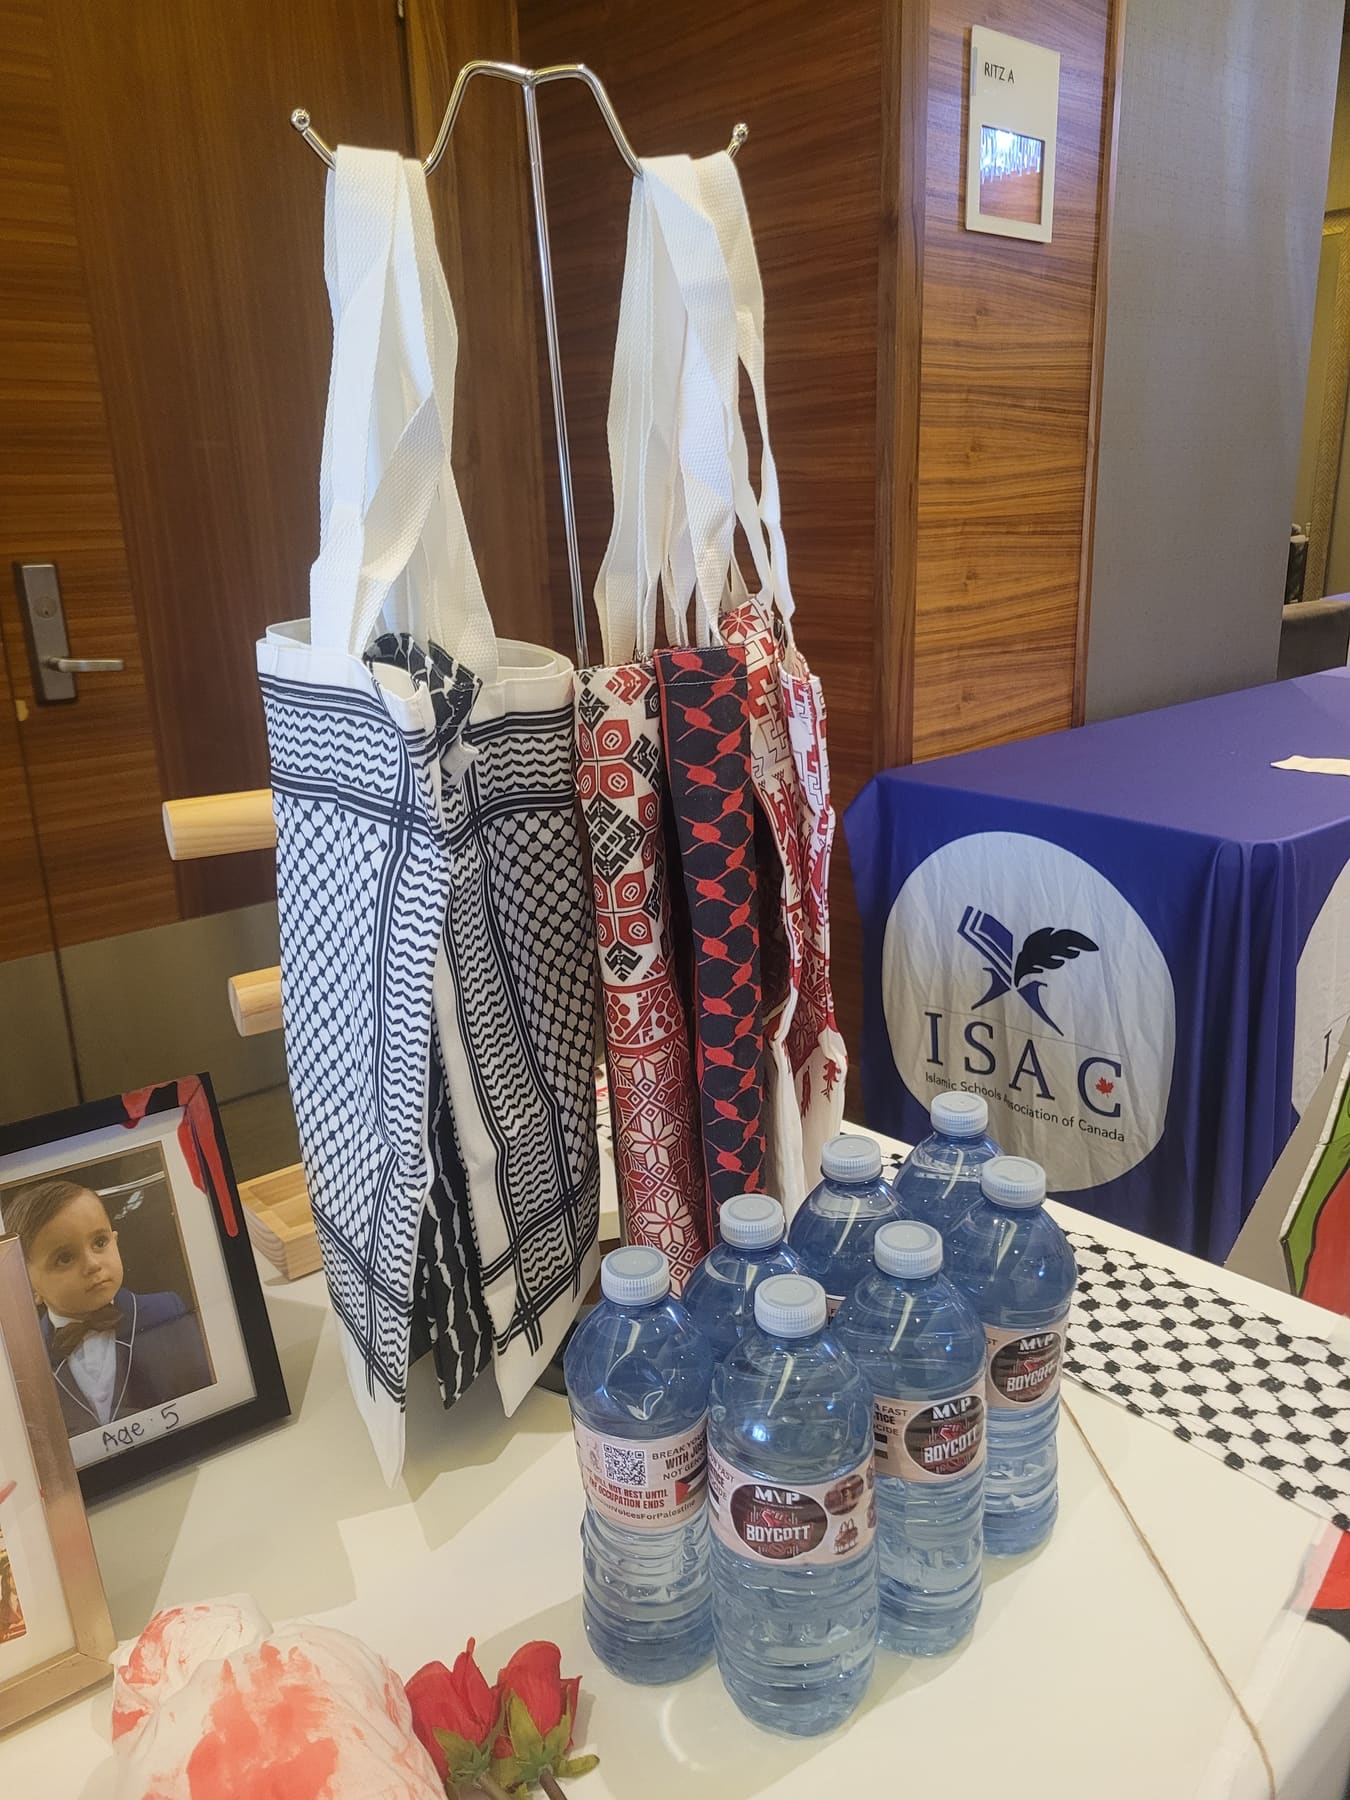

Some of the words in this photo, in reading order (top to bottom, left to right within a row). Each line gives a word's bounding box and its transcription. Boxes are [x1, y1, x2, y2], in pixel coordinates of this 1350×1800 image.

[984, 62, 1005, 81] RITZ
[1007, 69, 1015, 84] A
[924, 1011, 1122, 1118] ISAC
[925, 1072, 957, 1092] Islamic
[960, 1081, 1002, 1101] Schools
[1003, 1094, 1058, 1124] Association
[1062, 1116, 1074, 1128] of
[1078, 1119, 1125, 1143] Canada
[1019, 1334, 1054, 1351] MVP
[1006, 1360, 1057, 1393] BOYCOTT
[160, 1402, 180, 1430] 5
[873, 1411, 896, 1425] TICE
[882, 1405, 909, 1417] FAST
[932, 1397, 972, 1420] MVP
[873, 1424, 900, 1437] CIDE
[652, 1444, 686, 1460] BREAK
[924, 1424, 978, 1464] BOYCOTT
[665, 1451, 689, 1470] WITH
[663, 1467, 683, 1481] NOT
[598, 1485, 641, 1509] OCCUPATION
[643, 1499, 665, 1510] ENDS
[608, 1482, 622, 1495] NOT
[624, 1488, 643, 1500] REST
[645, 1488, 669, 1500] UNTIL
[754, 1485, 801, 1506] MVP
[746, 1523, 811, 1543] BOYCOTT
